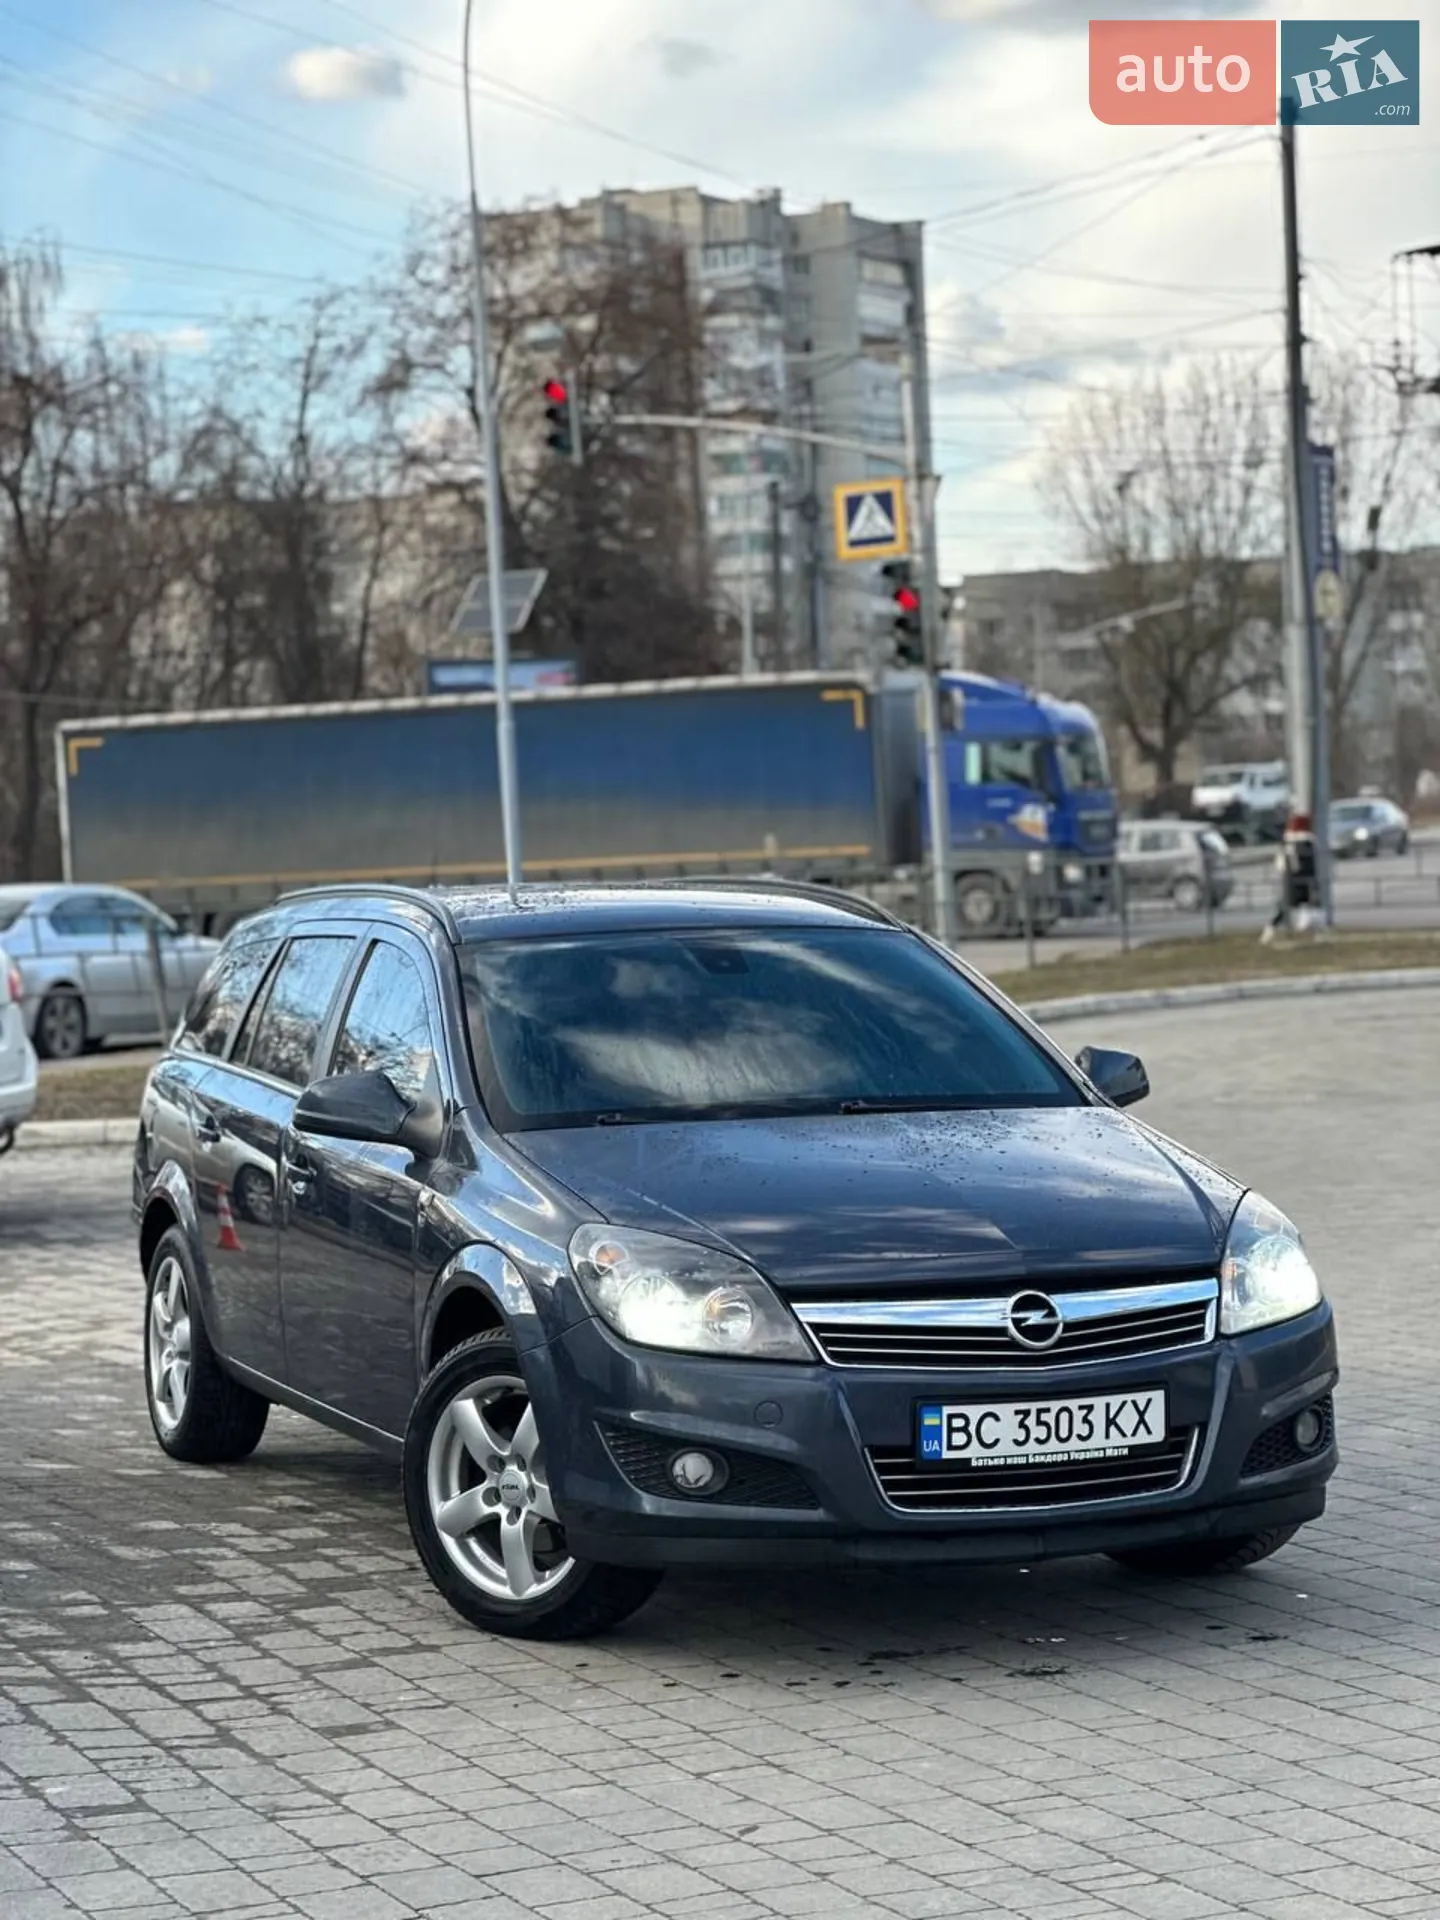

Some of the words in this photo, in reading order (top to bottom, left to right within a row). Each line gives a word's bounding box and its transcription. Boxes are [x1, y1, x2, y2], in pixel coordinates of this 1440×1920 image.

[946, 1411, 1001, 1452] BC
[1012, 1404, 1094, 1447] 3503
[1105, 1398, 1153, 1440] KX
[923, 1441, 940, 1452] UA
